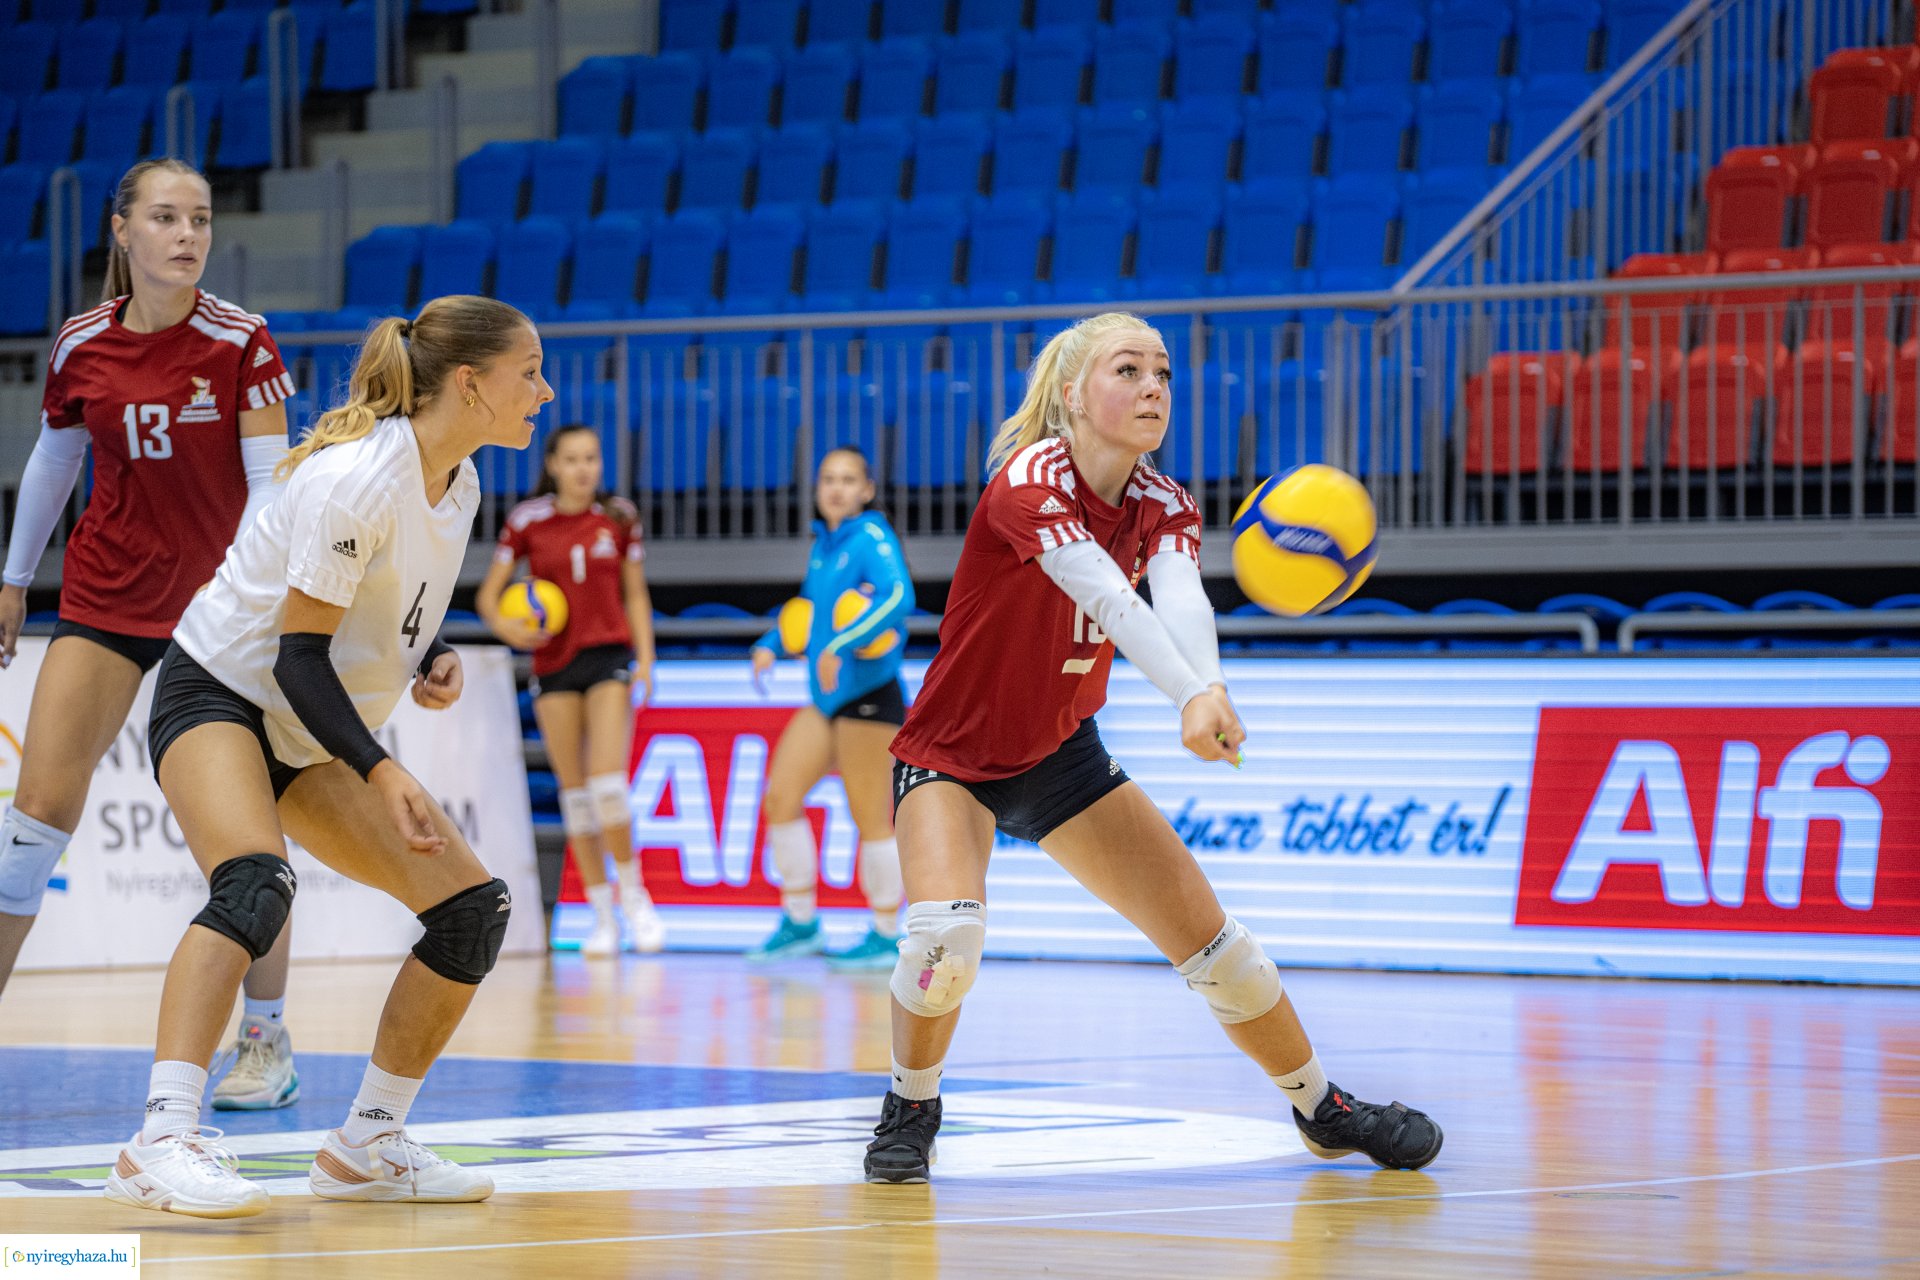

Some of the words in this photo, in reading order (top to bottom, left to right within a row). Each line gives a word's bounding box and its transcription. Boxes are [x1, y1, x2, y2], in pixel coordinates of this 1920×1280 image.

[123, 403, 174, 460] 13
[331, 543, 358, 559] adidas
[570, 544, 587, 585] 1
[401, 581, 427, 648] 4
[1550, 730, 1891, 910] Alfi
[963, 901, 980, 910] asics
[1210, 931, 1228, 950] asics
[358, 1110, 394, 1121] umbro
